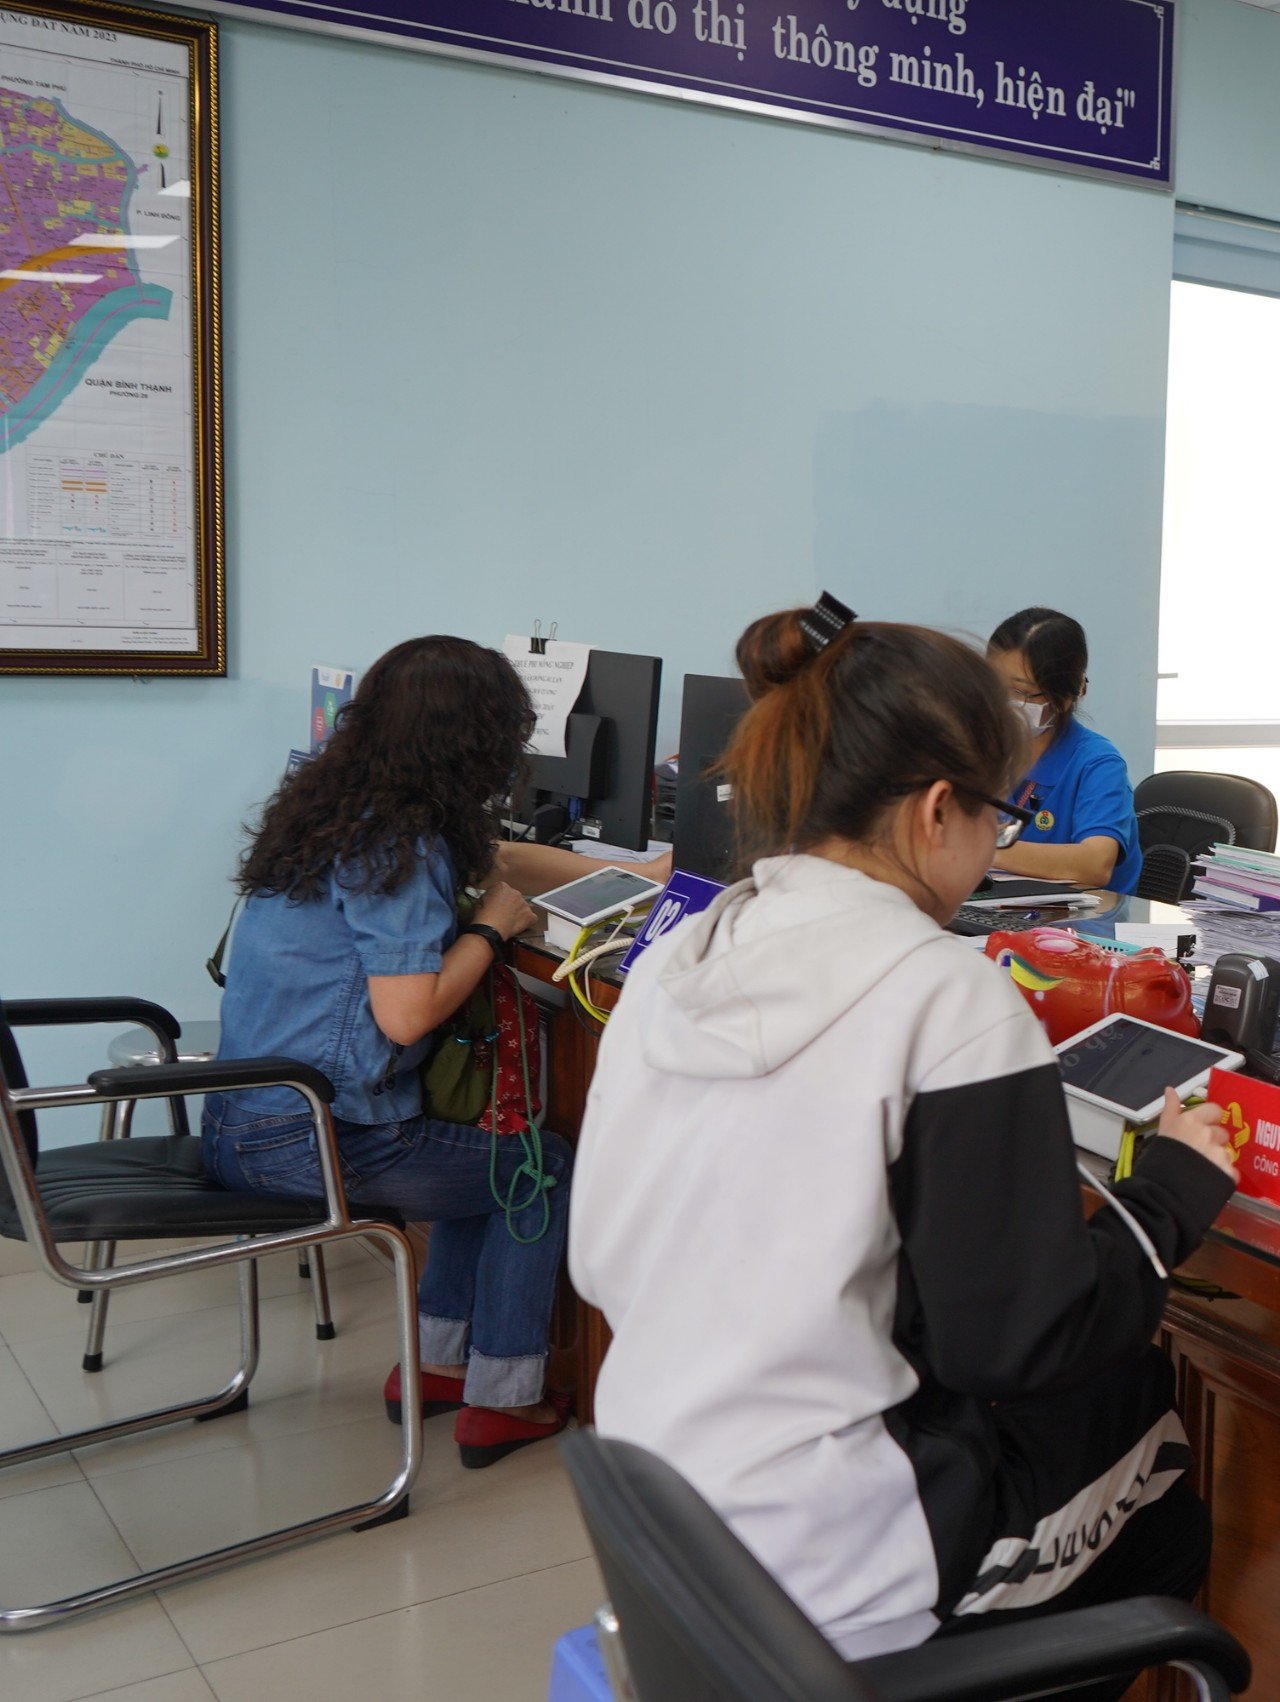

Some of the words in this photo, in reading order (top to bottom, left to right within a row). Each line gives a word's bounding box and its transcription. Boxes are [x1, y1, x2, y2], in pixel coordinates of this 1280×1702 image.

[94, 29, 117, 42] 2023
[692, 0, 747, 61] thị
[772, 15, 879, 87] thông
[889, 45, 985, 109] minh,
[994, 60, 1066, 120] hiện
[1075, 80, 1136, 135] đại"
[1253, 1154, 1279, 1176] CÔNG
